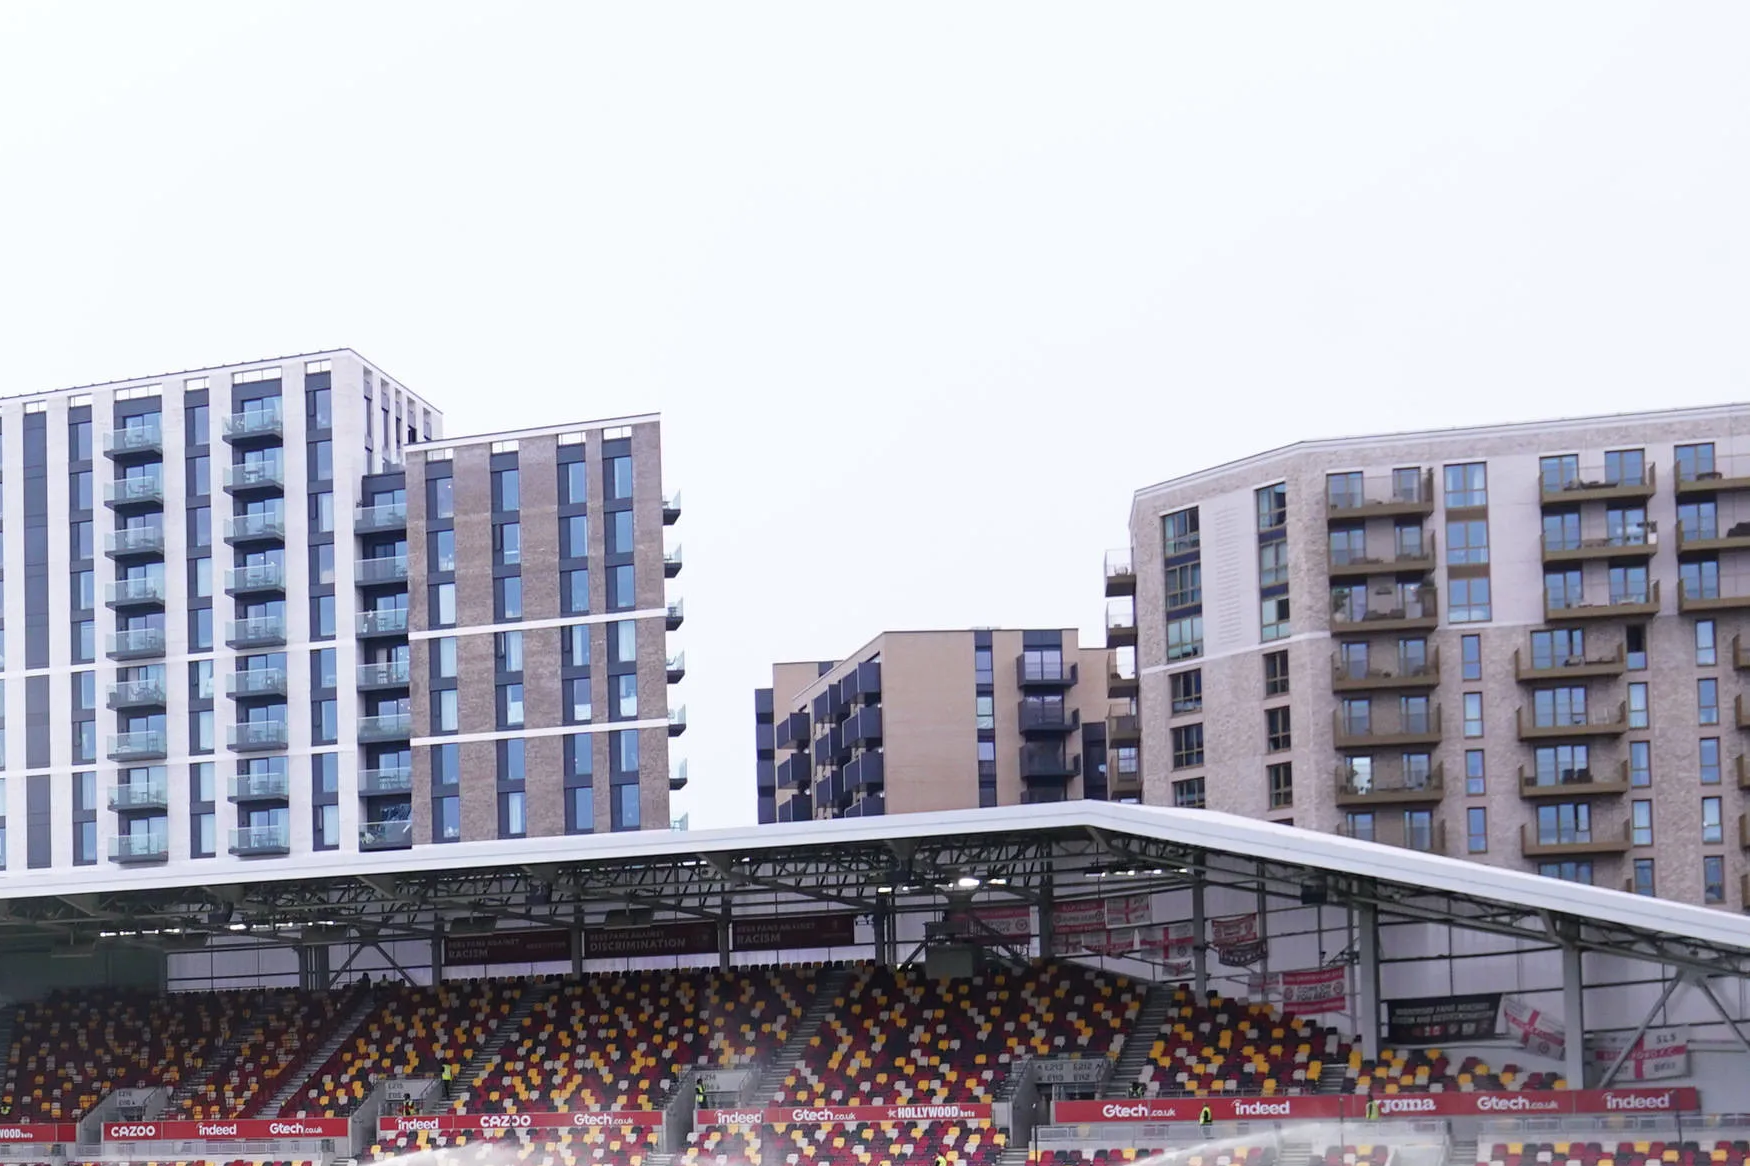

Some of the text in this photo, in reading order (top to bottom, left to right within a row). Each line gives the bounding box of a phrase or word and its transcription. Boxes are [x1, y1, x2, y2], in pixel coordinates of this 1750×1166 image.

[589, 937, 687, 951] DISCRIMINATION
[736, 933, 780, 945] RACISM
[448, 948, 489, 959] RACISM
[1603, 1091, 1670, 1109] indeed
[792, 1108, 857, 1122] Gtech.co.uk
[1103, 1103, 1176, 1118] Gtech.co.uk
[1233, 1100, 1291, 1116] indeed
[396, 1117, 440, 1131] indeed
[480, 1116, 531, 1128] CAZOO
[574, 1113, 635, 1126] Gtech.co.uk
[714, 1110, 762, 1124] indeed
[110, 1125, 156, 1138] CAZOO
[196, 1122, 237, 1136] indeed
[269, 1122, 324, 1135] Gtech.co.uk
